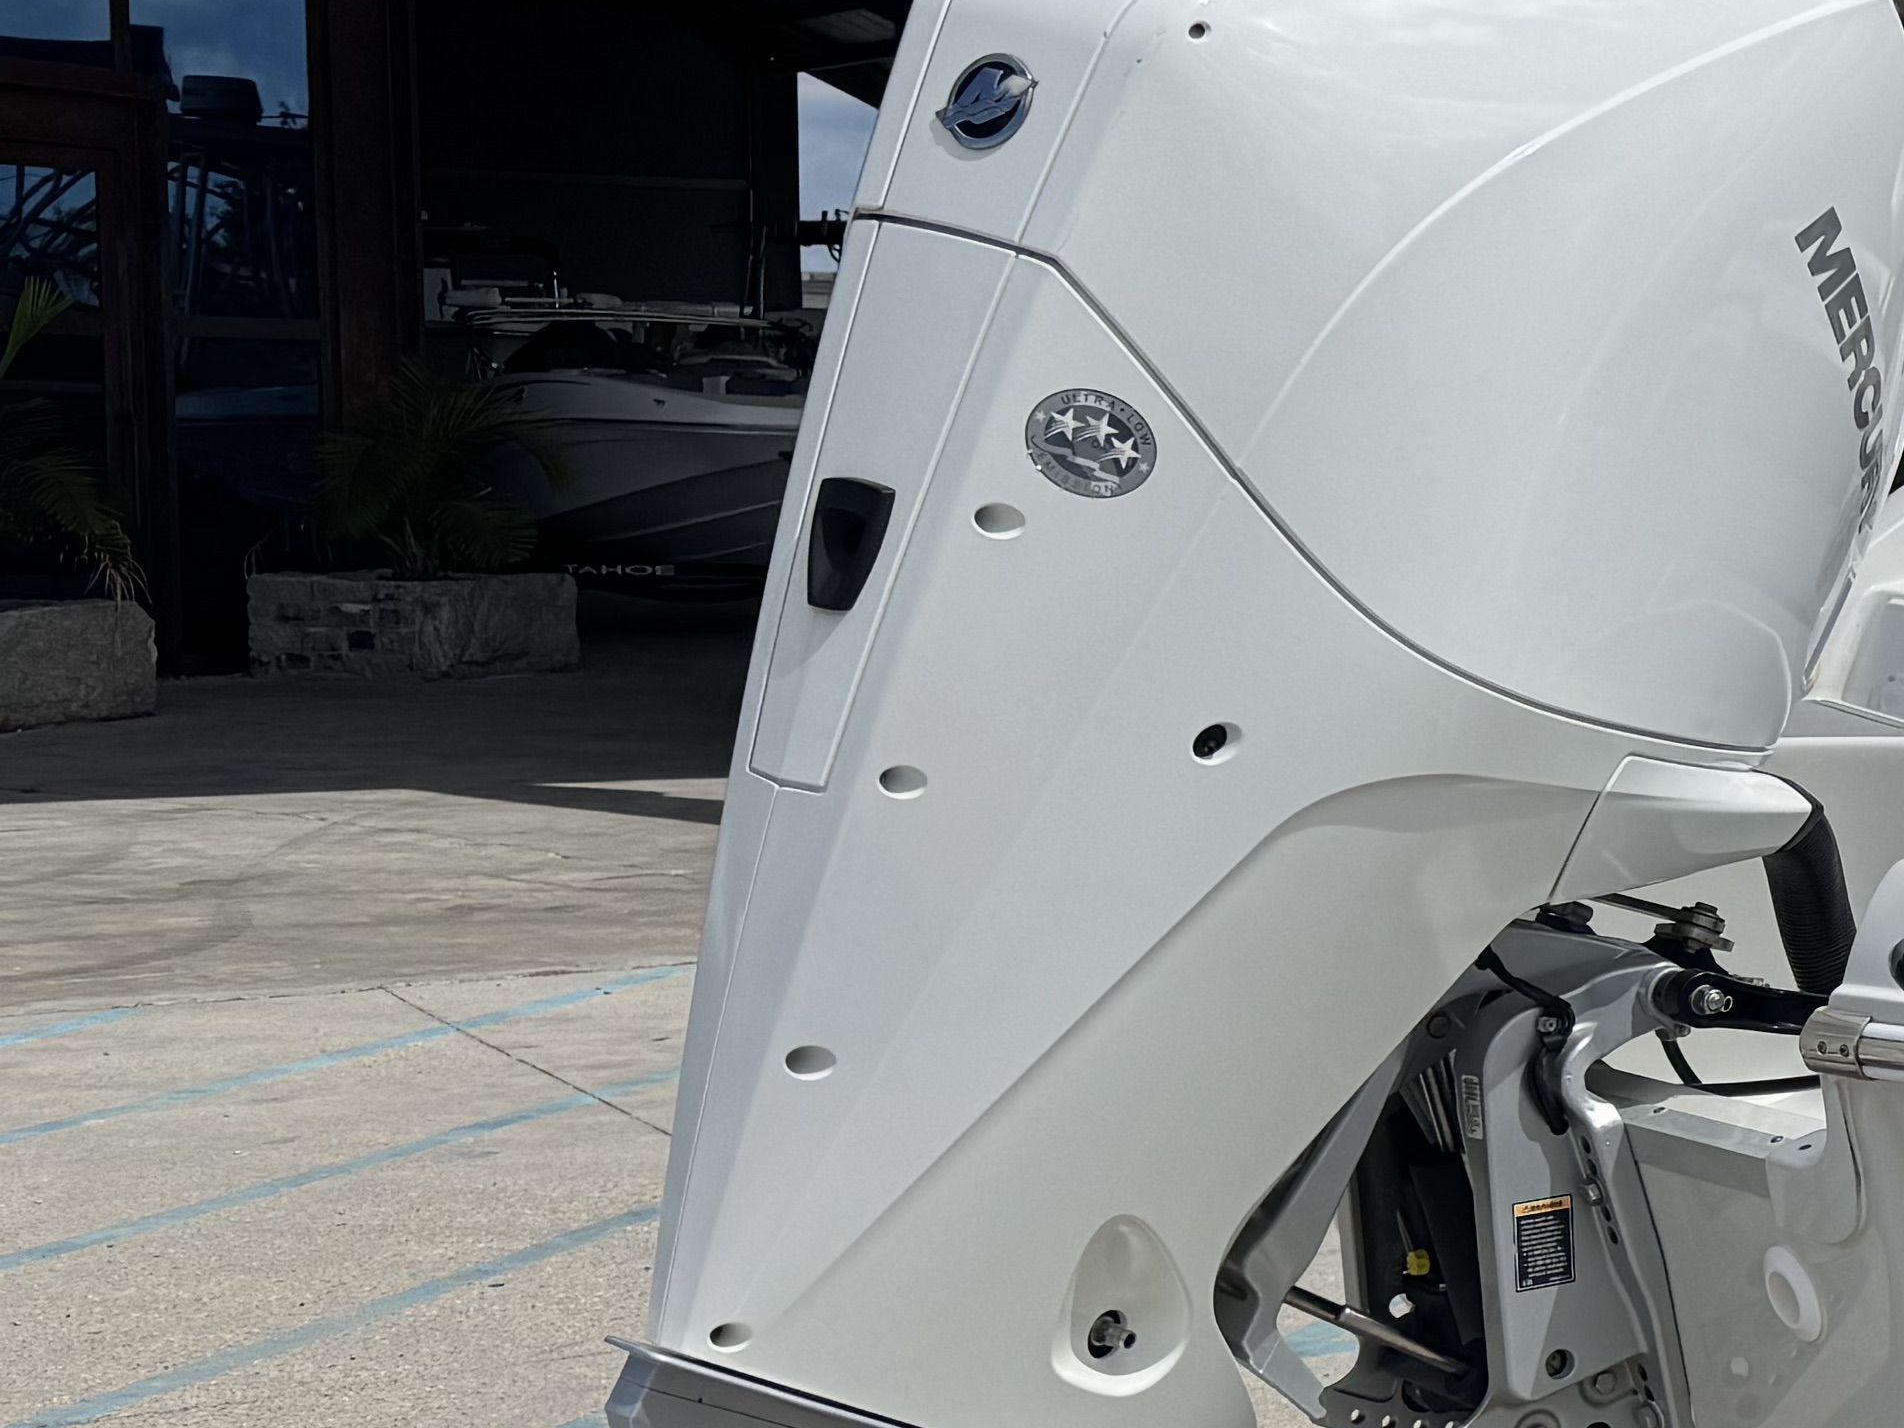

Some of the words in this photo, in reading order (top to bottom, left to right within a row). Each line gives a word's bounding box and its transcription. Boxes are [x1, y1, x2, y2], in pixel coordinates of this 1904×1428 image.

[1060, 392, 1117, 412] ULTRA
[1126, 412, 1152, 447] LOW
[561, 563, 676, 576] TAHOE
